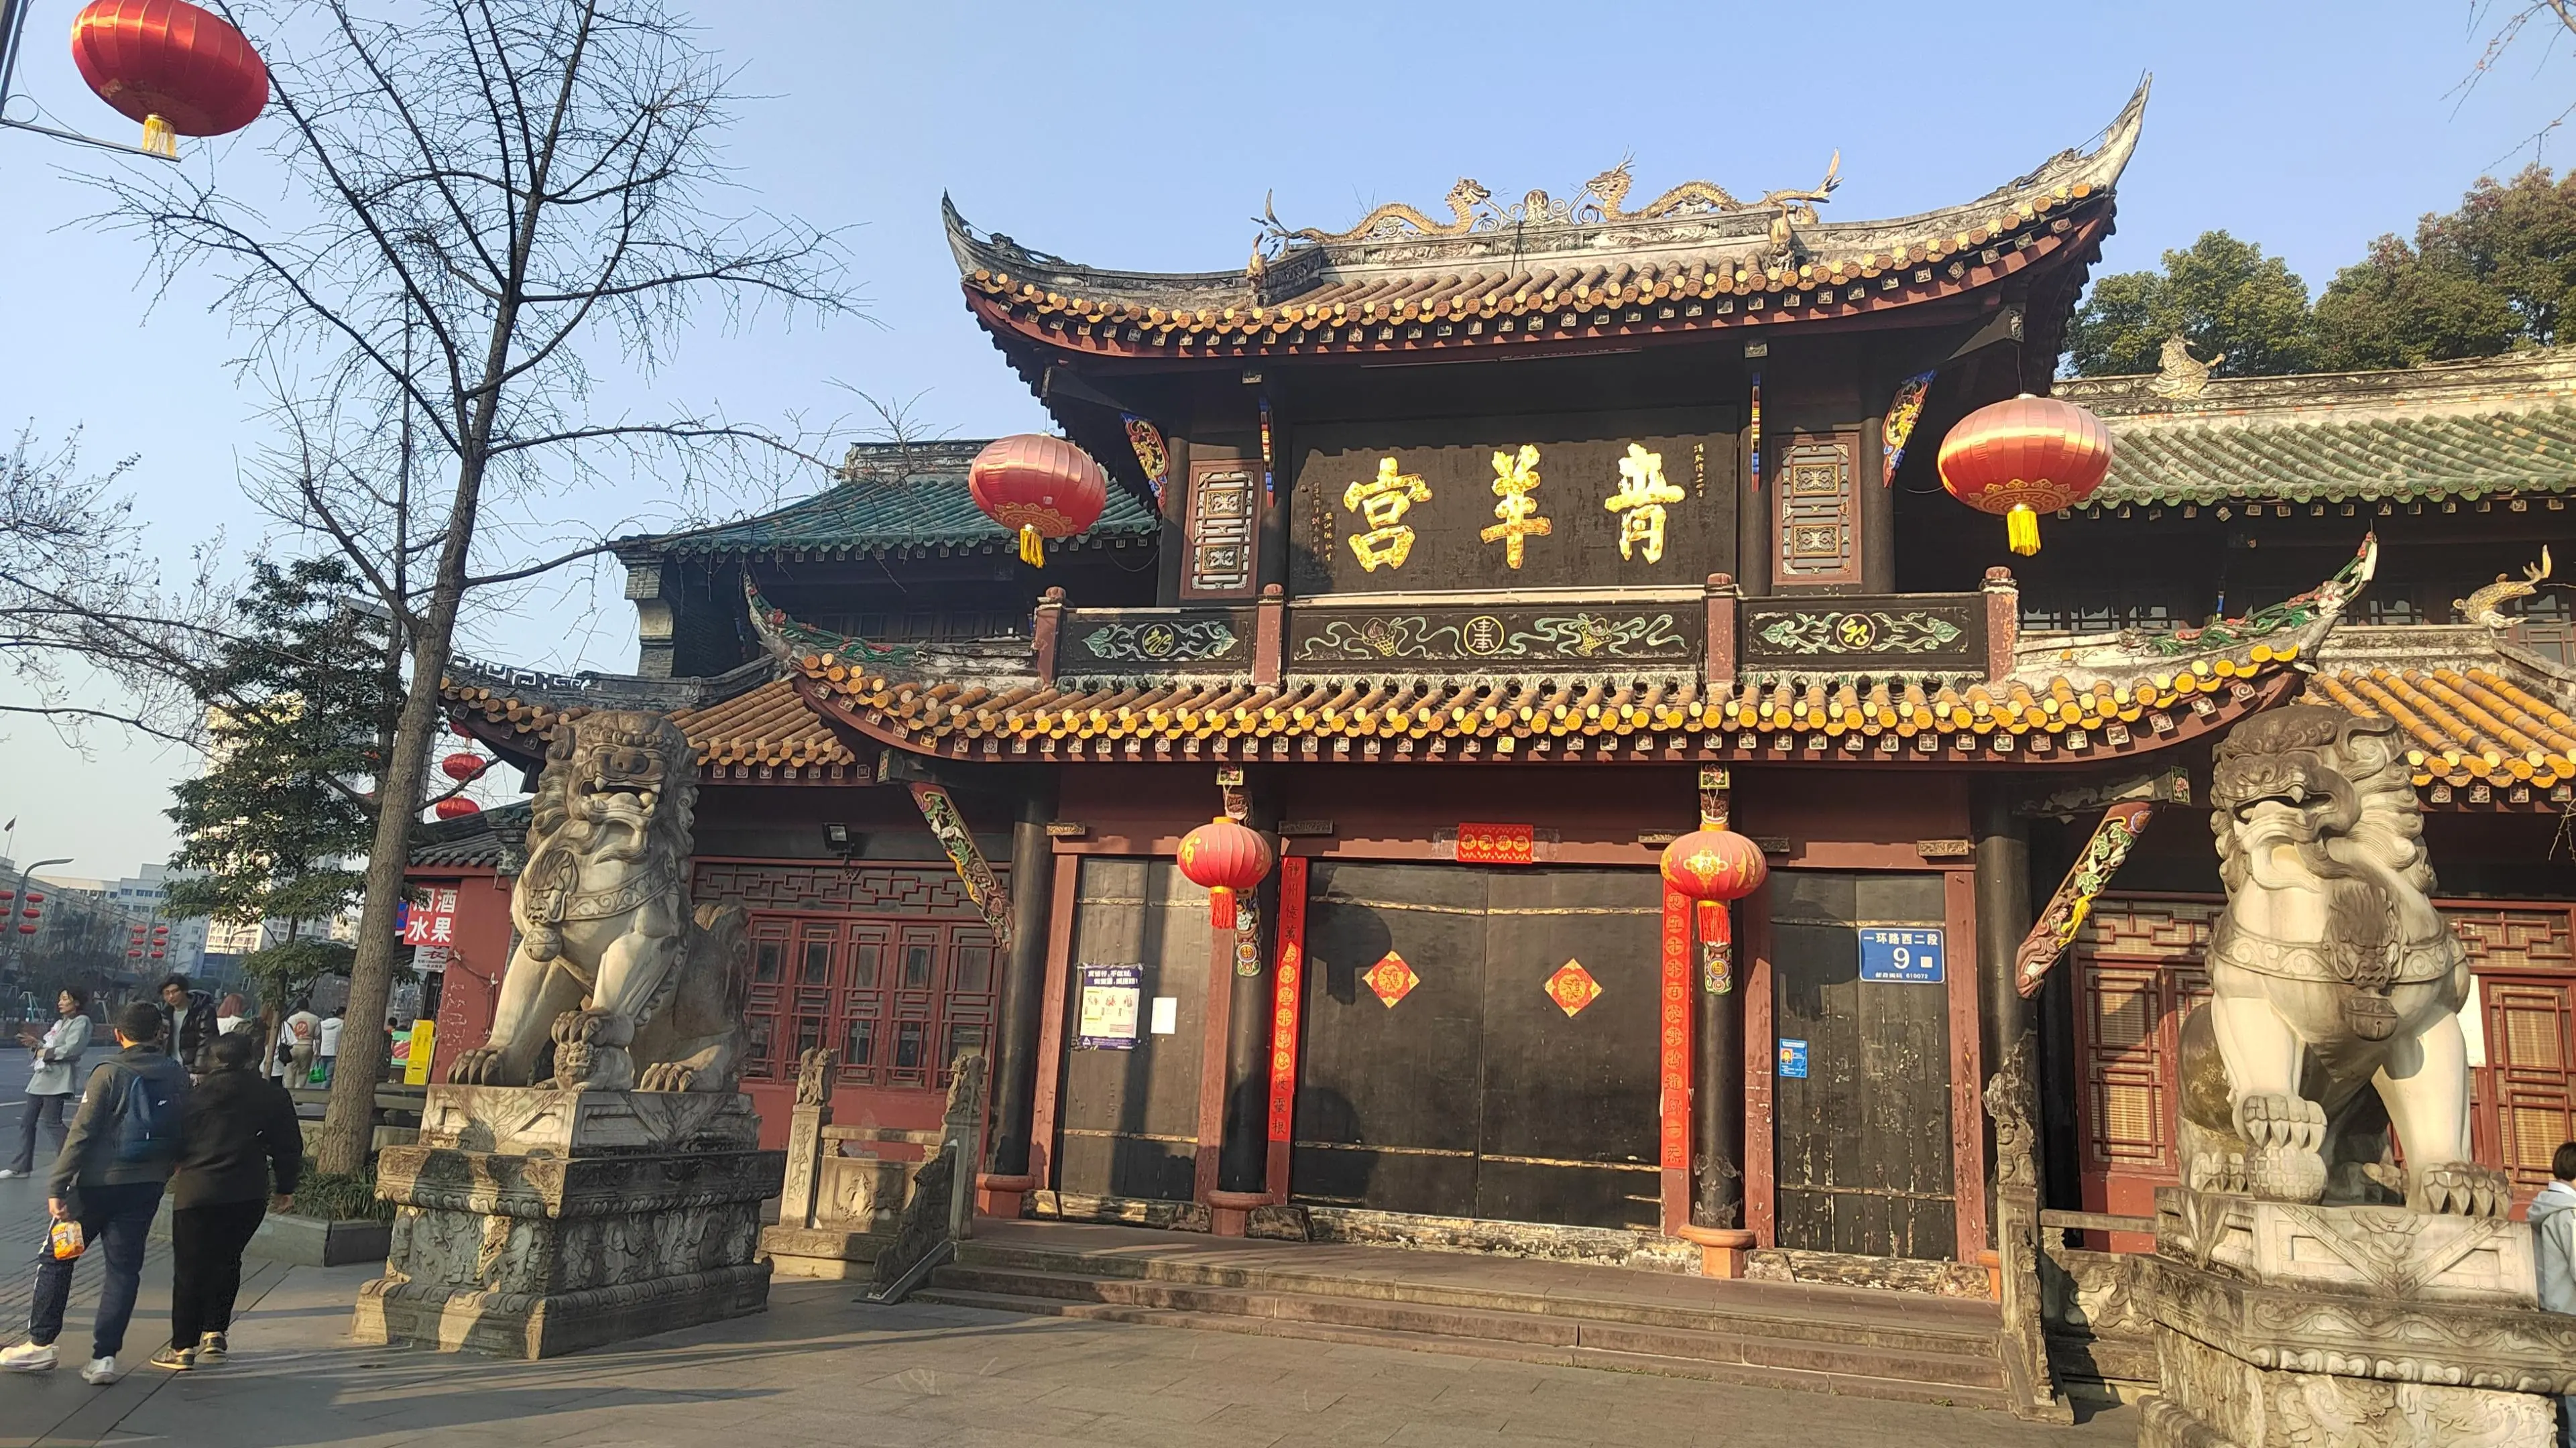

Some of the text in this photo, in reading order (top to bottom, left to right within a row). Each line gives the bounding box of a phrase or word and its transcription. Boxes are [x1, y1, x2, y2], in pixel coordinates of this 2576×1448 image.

[408, 916, 452, 943] 水果
[1863, 932, 1938, 945] 一环路西二段
[1893, 947, 1910, 969] 9
